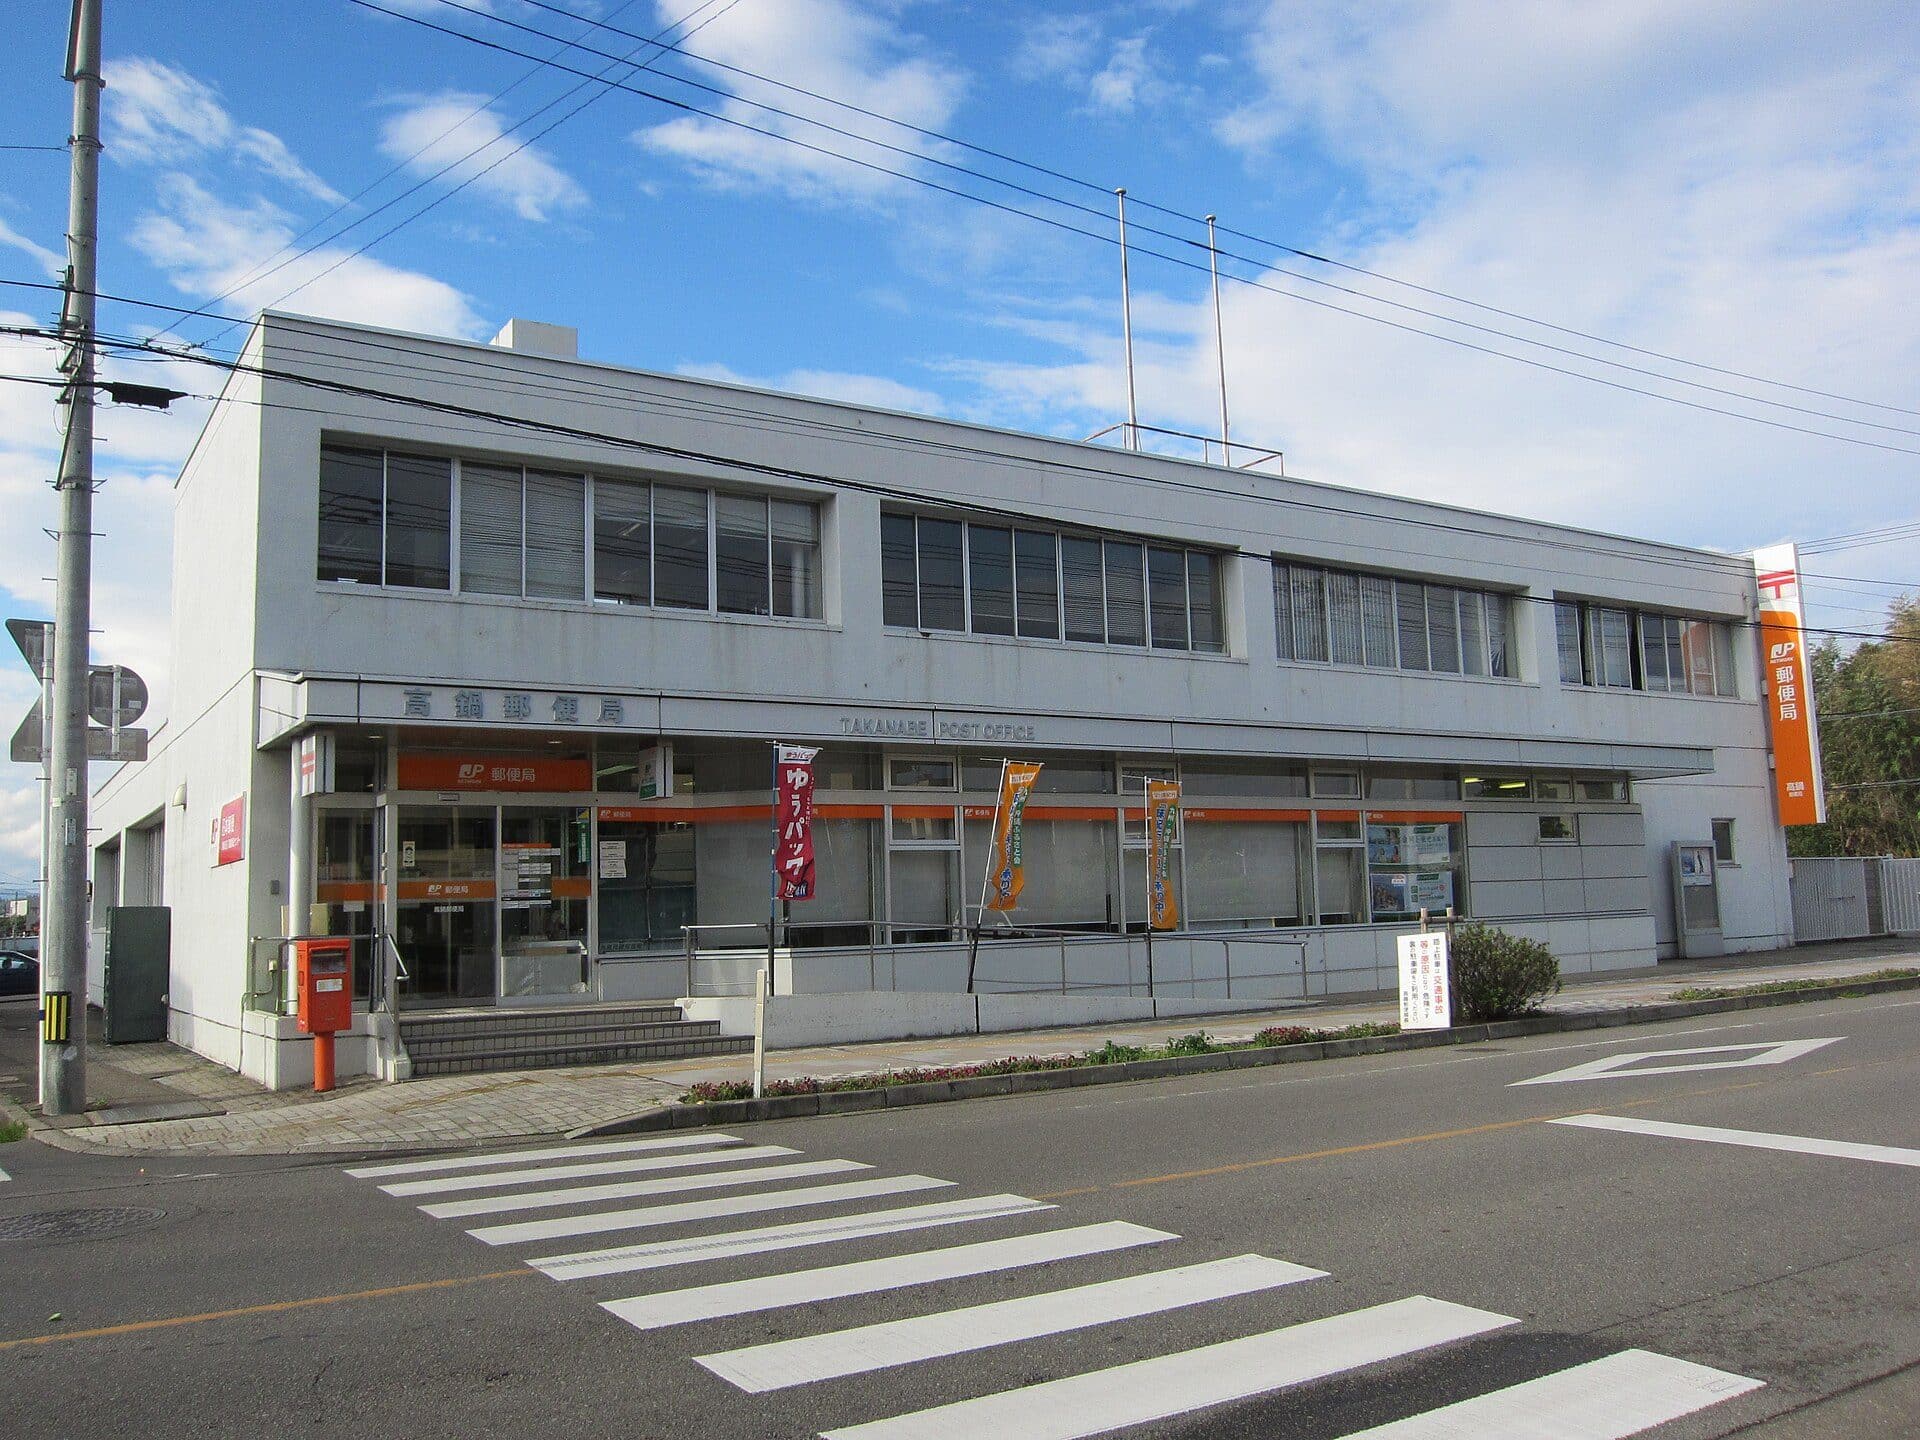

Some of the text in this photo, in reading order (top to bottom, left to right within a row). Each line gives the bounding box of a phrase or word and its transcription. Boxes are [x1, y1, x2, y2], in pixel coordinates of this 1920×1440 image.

[403, 688, 624, 724] 高鍋郵便局
[1776, 665, 1797, 721] 郵便局
[840, 717, 1035, 741] TAKANABE POST OFFICE
[491, 767, 536, 783] 郵便局
[784, 767, 809, 876] ゆうパック
